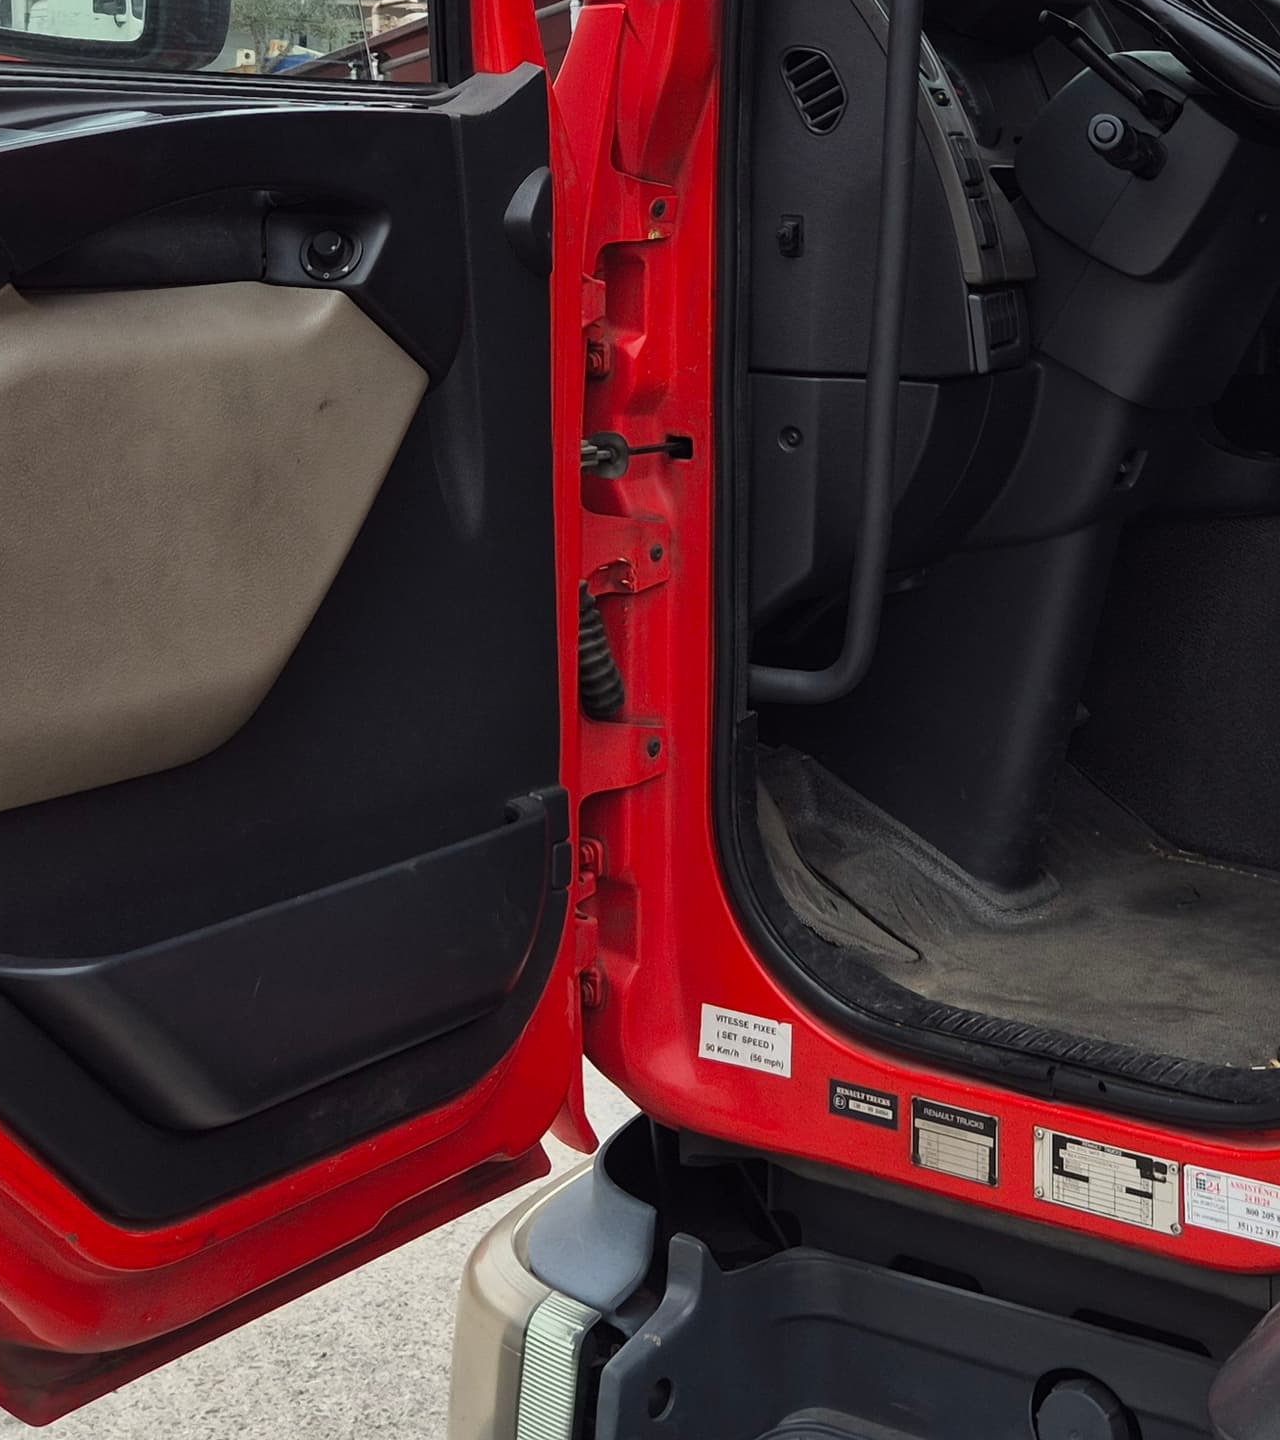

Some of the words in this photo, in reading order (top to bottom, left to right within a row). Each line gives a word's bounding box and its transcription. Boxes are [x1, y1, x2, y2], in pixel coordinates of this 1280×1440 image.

[716, 1014, 749, 1029] VITESSE
[753, 1023, 777, 1035] FIXEE
[717, 1045, 740, 1058] Km/h
[764, 1058, 784, 1070] mph)
[923, 1107, 954, 1122] RENAULT
[956, 1116, 985, 1130] TRUCKS
[1206, 1180, 1221, 1195] 24
[1262, 1210, 1275, 1221] 205
[1255, 1225, 1264, 1235] 22
